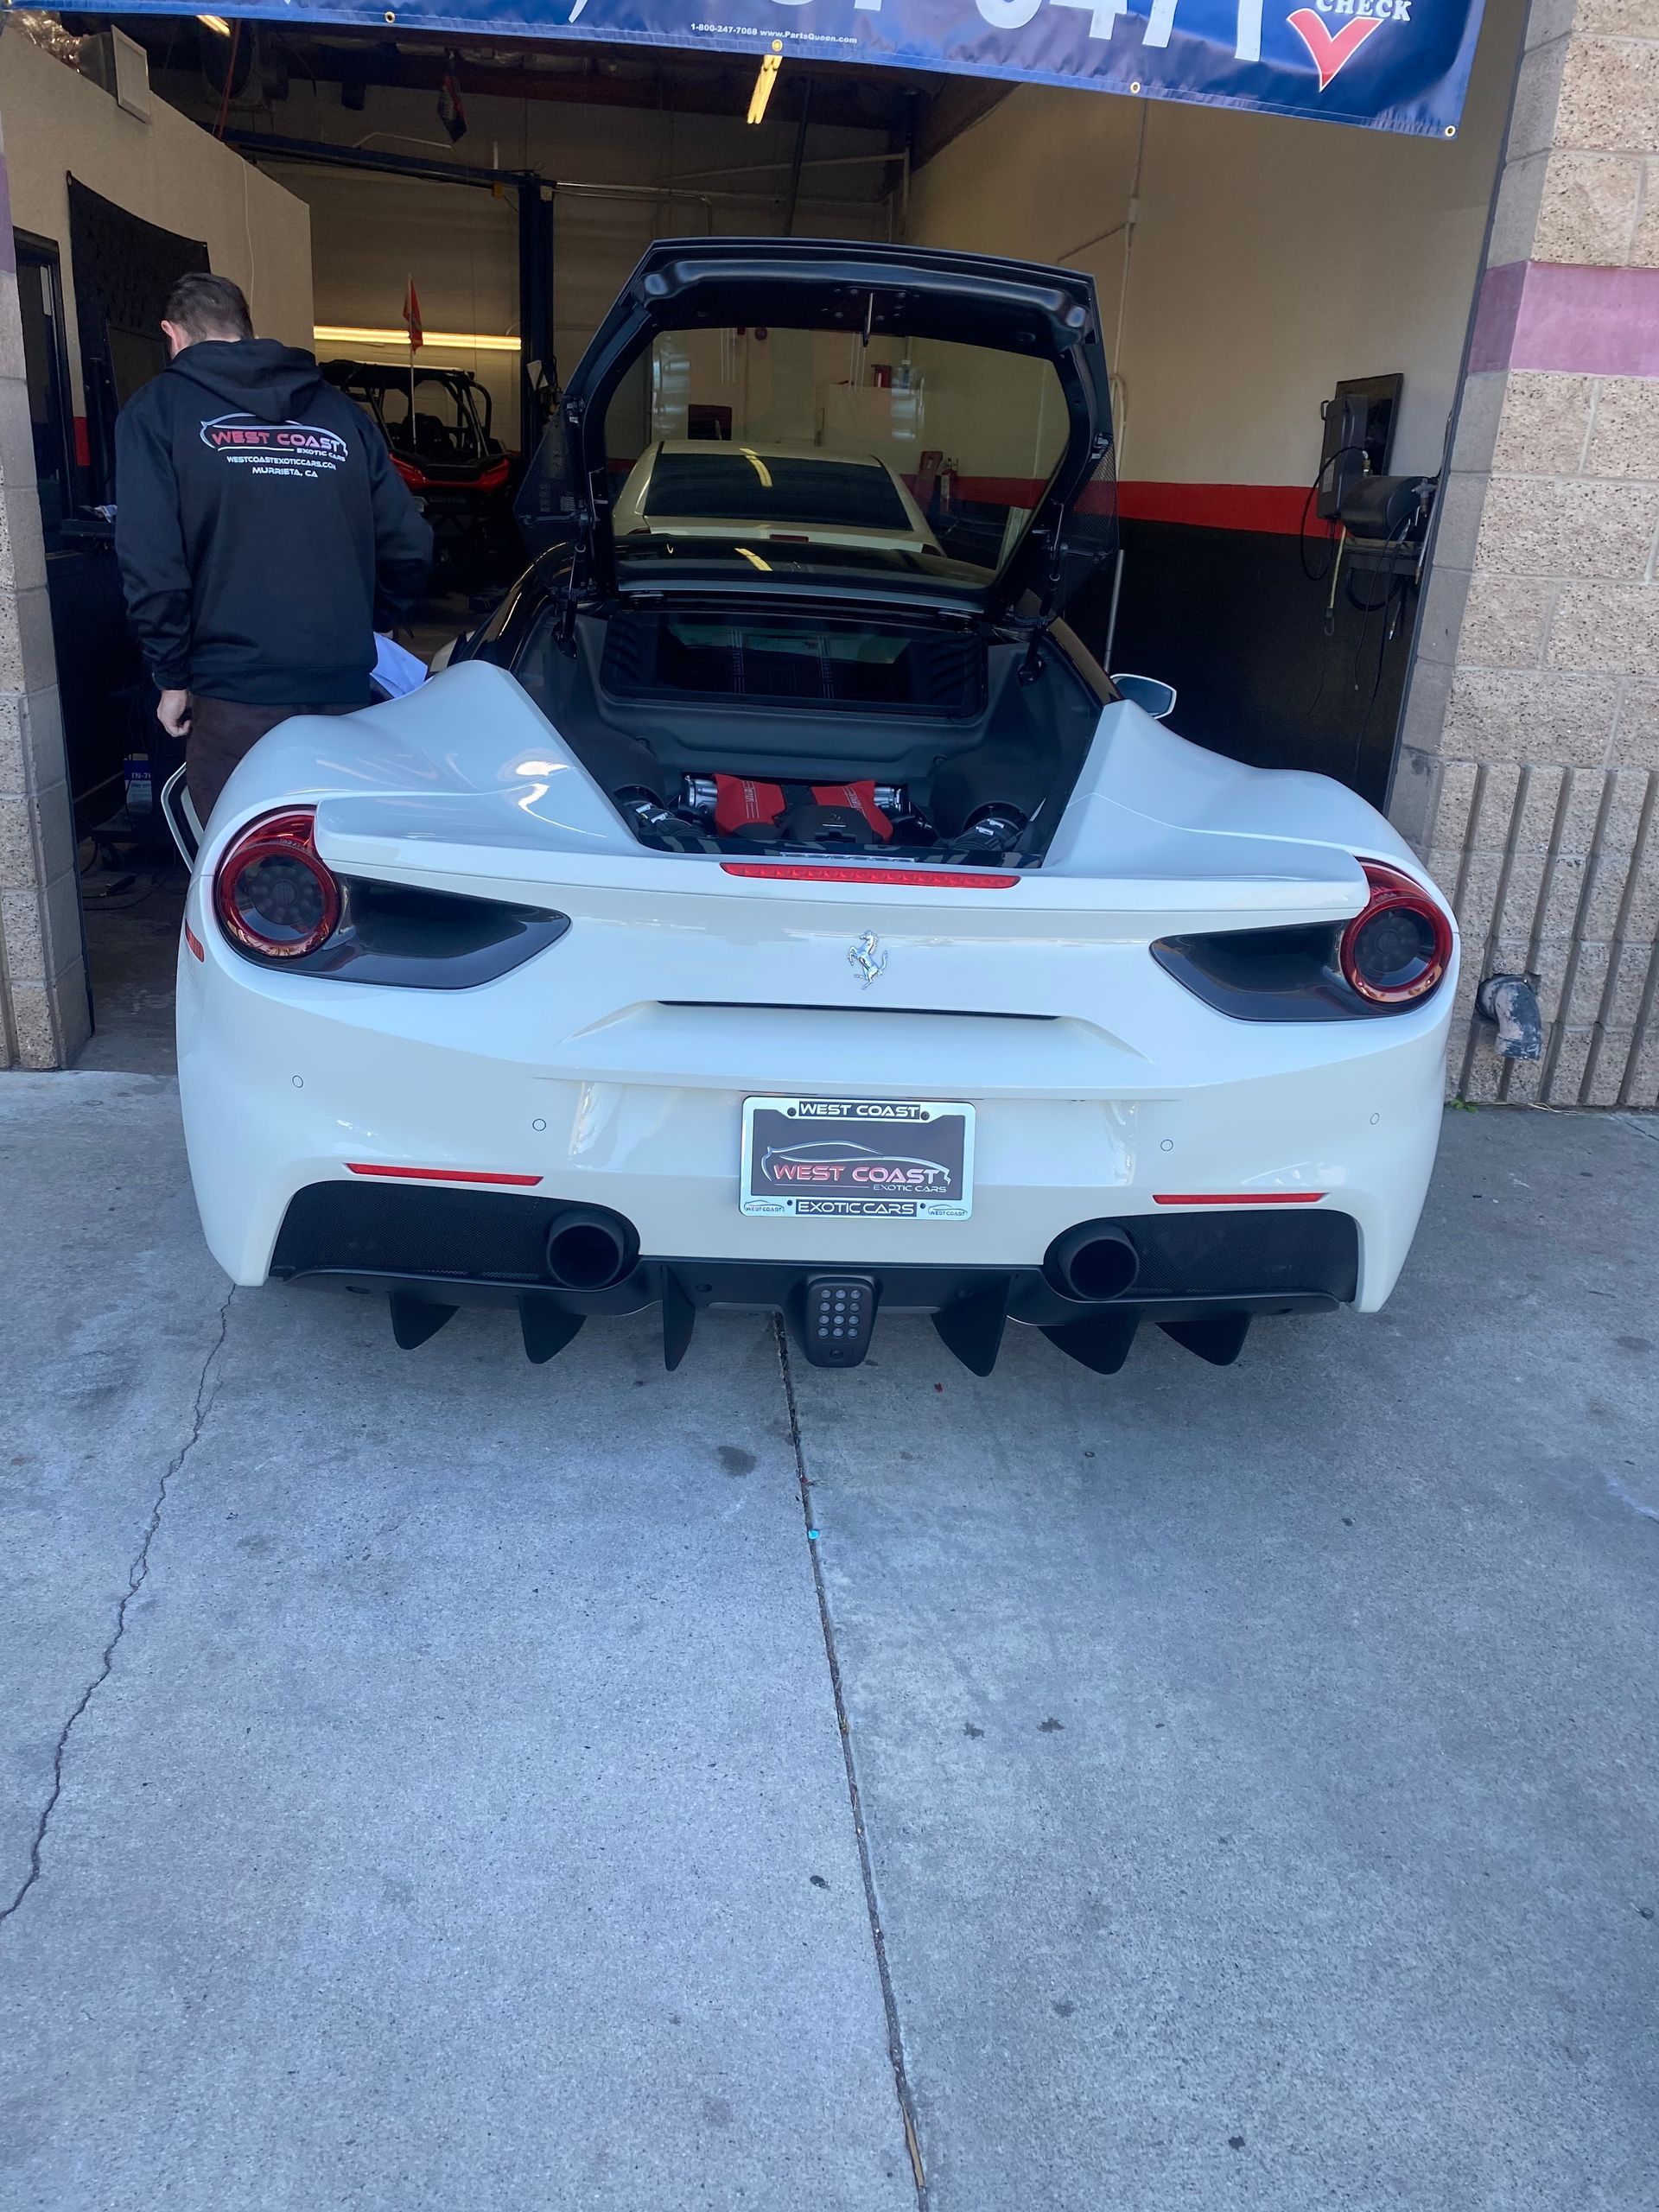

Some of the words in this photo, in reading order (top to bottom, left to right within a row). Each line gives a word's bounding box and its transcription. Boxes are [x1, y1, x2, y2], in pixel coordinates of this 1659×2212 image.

[1315, 0, 1413, 22] CHECK
[760, 29, 857, 44] www.PartsQueen.com
[212, 430, 270, 445] WEST
[276, 433, 340, 452] COAST
[296, 448, 327, 457] EXOTIC
[328, 452, 346, 461] CARS
[252, 467, 303, 477] MURRIETA,
[800, 1103, 852, 1116] WEST
[855, 1105, 919, 1118] COAST
[773, 1164, 845, 1181] WEST
[852, 1166, 940, 1185] COAST
[873, 1184, 912, 1192] EXOTIC
[914, 1185, 947, 1193] CARS
[798, 1201, 861, 1214] EXOTIC
[862, 1203, 915, 1215] CARS
